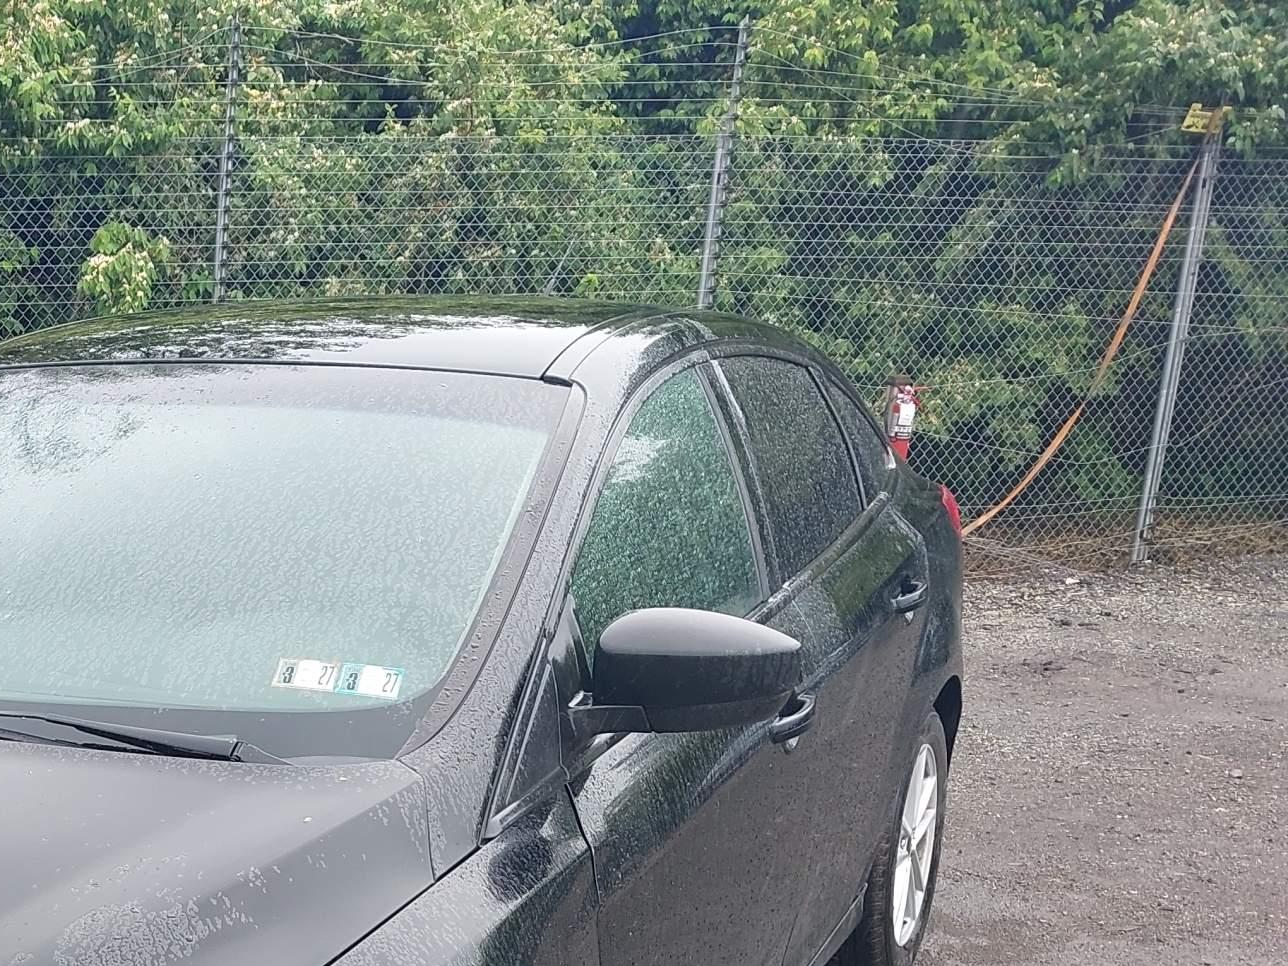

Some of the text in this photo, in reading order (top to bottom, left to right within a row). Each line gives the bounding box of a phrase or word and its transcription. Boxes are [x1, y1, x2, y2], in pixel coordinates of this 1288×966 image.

[282, 665, 335, 686] 3 27
[345, 672, 400, 693] 3 27
